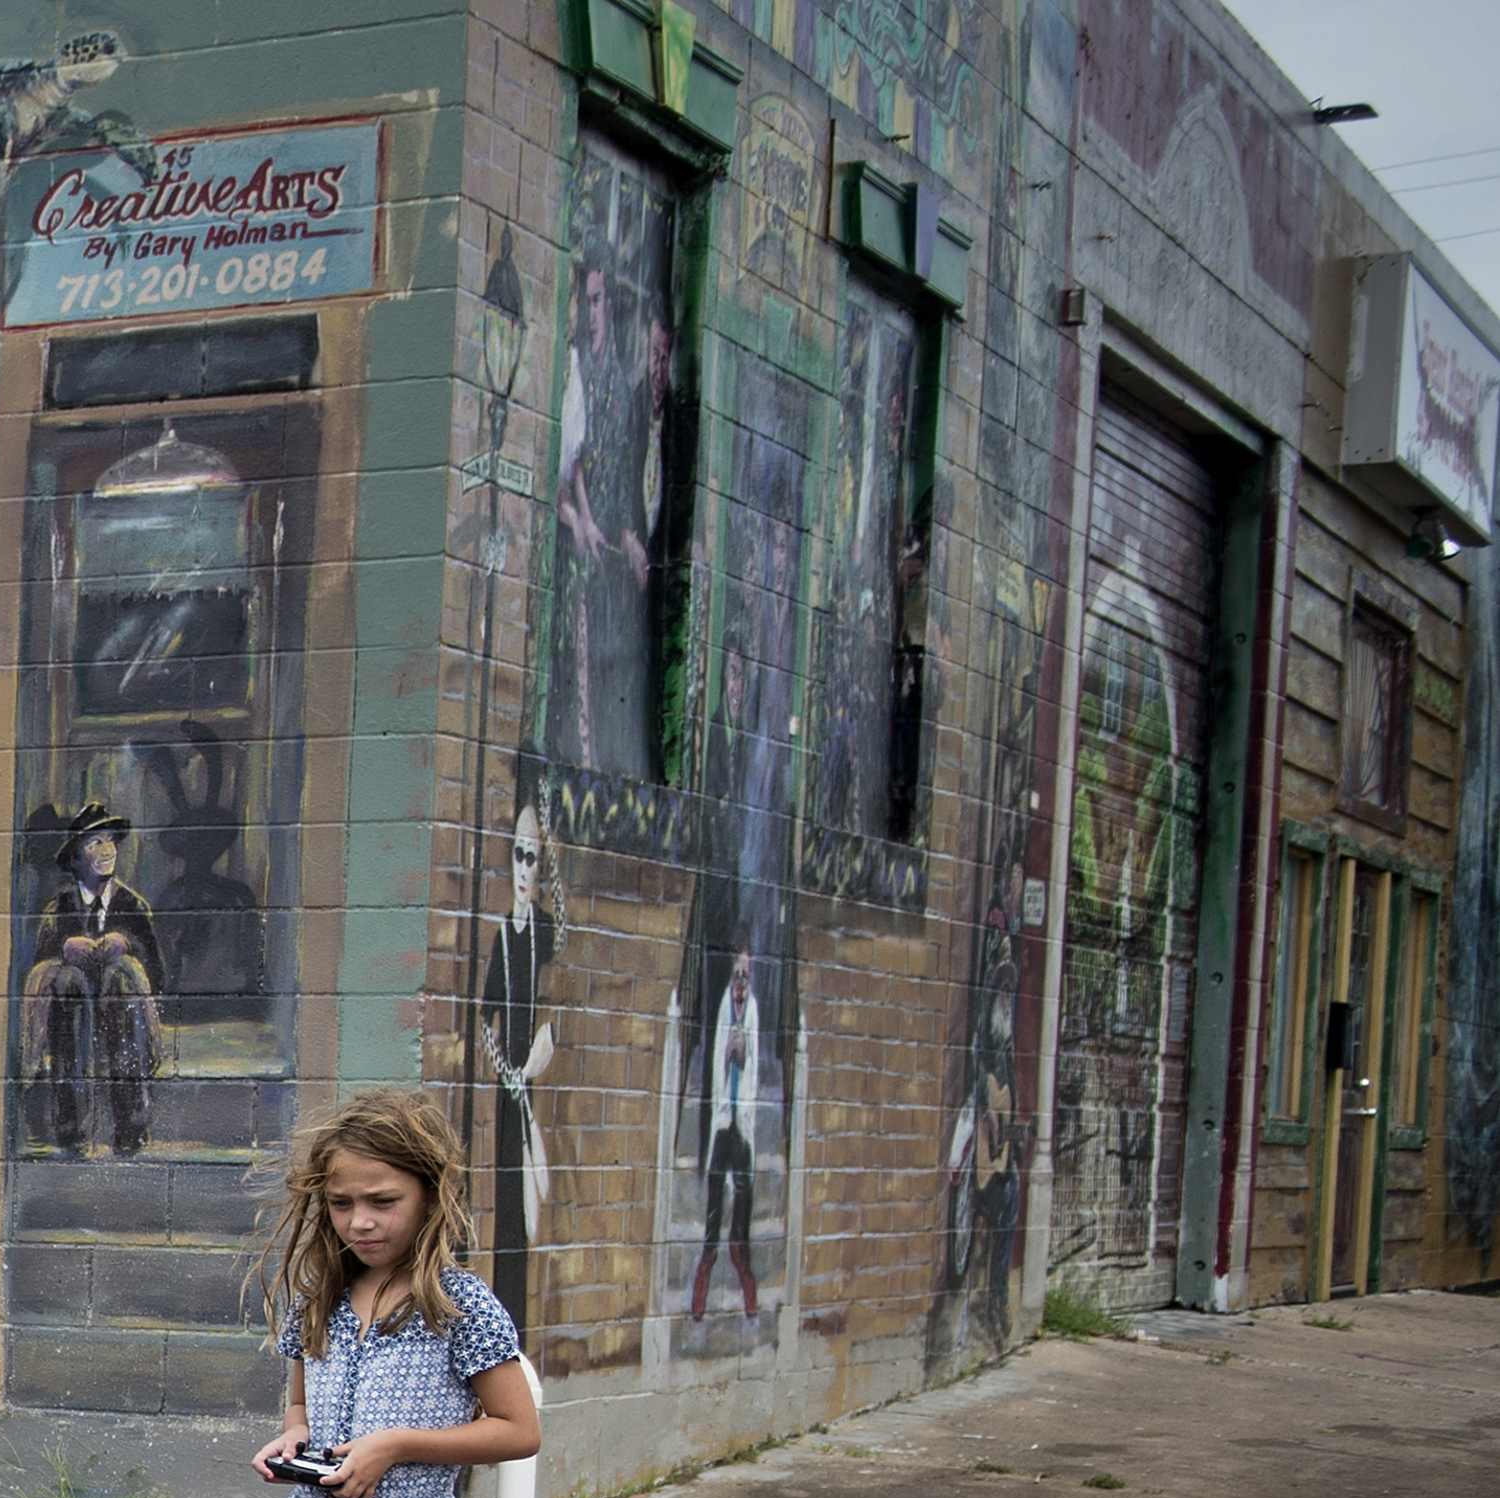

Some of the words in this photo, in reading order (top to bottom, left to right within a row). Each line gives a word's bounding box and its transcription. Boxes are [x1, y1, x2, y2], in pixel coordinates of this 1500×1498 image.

[83, 237, 119, 269] By
[134, 232, 198, 268] Gary
[203, 219, 310, 251] Holman
